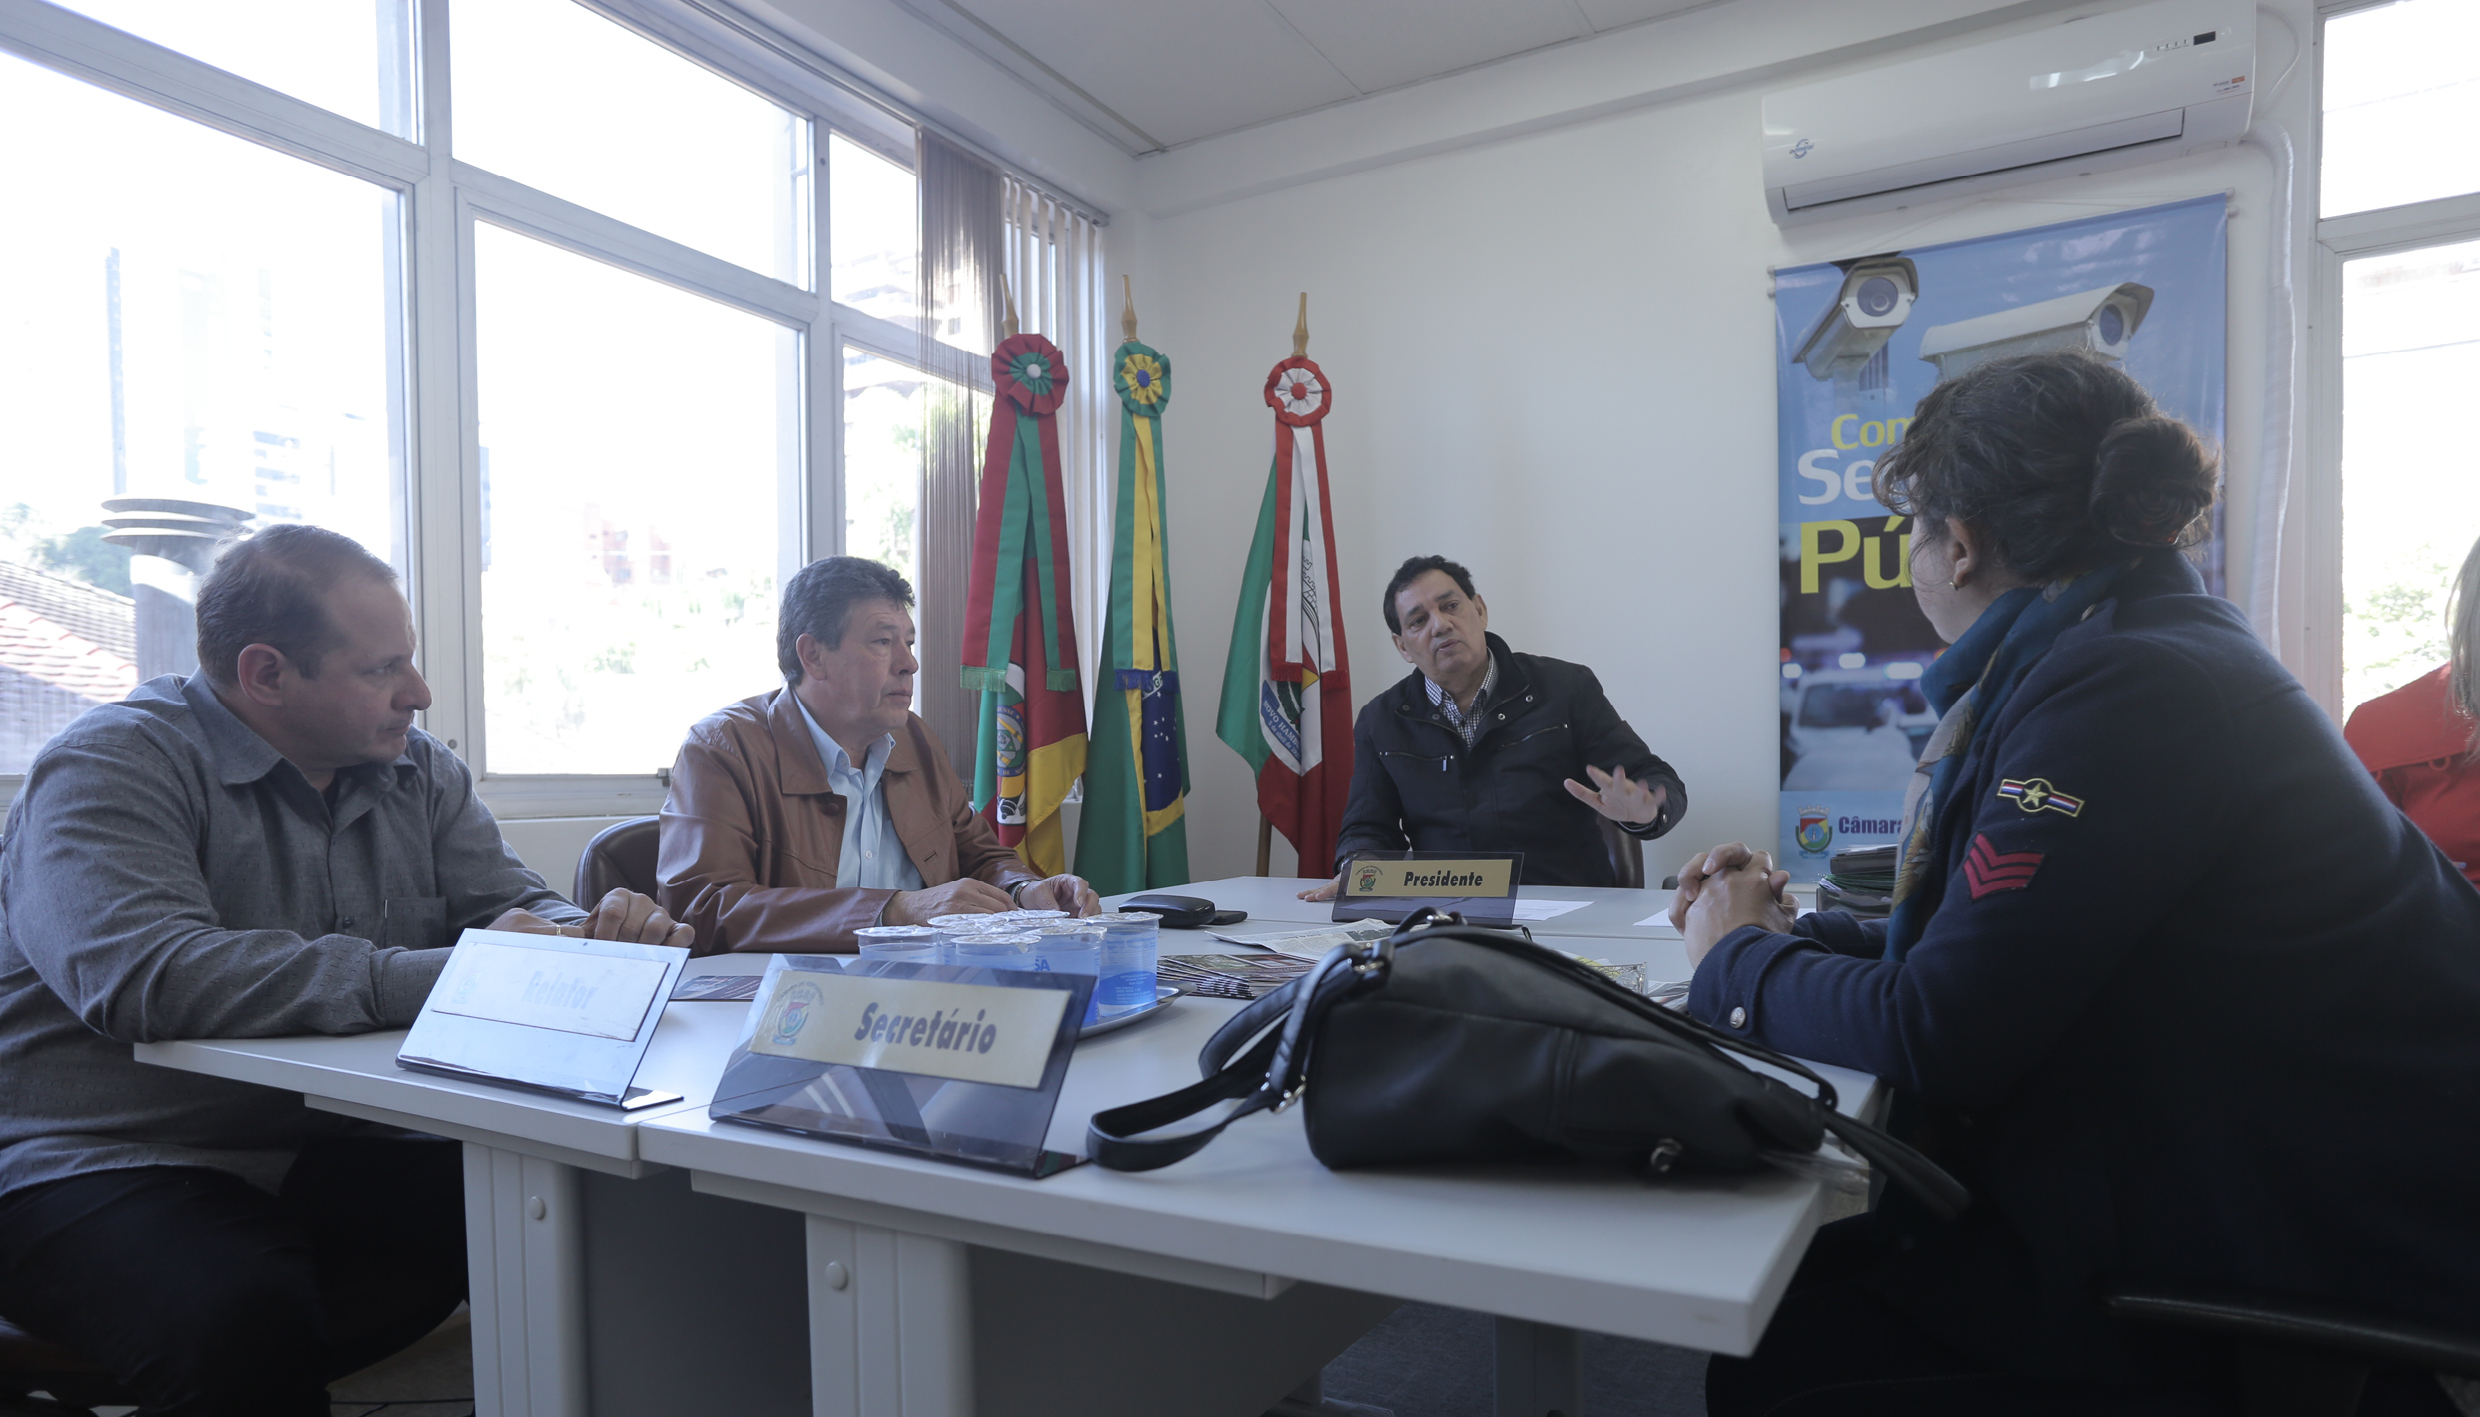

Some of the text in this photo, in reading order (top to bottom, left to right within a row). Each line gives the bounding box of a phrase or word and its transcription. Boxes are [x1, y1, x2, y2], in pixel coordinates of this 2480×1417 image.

[1801, 515, 1912, 594] Pú
[1403, 869, 1483, 887] Presidente
[522, 970, 598, 1010] Relator
[854, 1002, 997, 1054] Secretário
